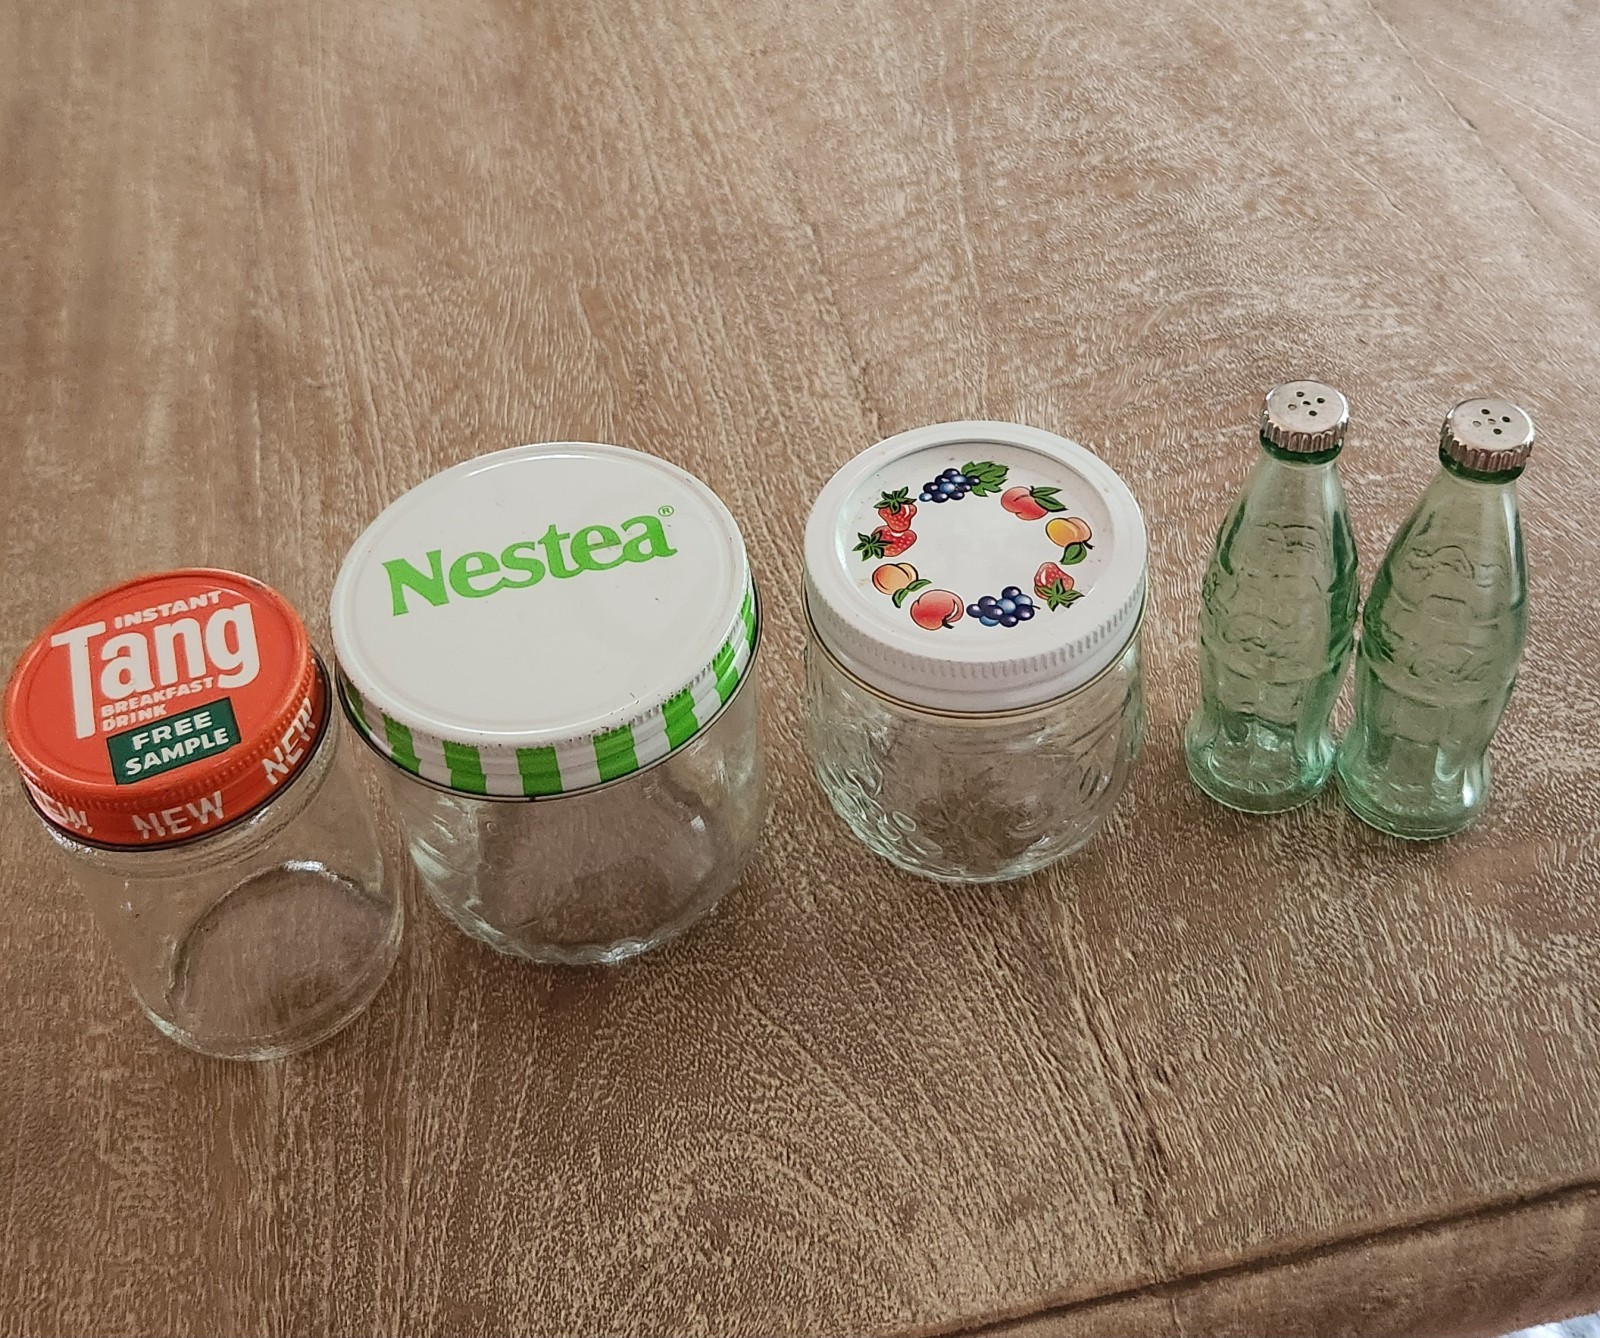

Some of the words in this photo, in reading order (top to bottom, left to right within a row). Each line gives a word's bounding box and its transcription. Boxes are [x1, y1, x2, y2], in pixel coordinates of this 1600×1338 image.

[114, 590, 222, 629] INSTANT
[51, 602, 260, 740] Tang
[101, 676, 214, 718] BREAKFAST
[102, 702, 167, 732] DRINK
[125, 727, 230, 776] SAMPLE
[132, 711, 213, 751] FREE
[262, 697, 315, 785] NEW
[132, 790, 224, 839] NEW
